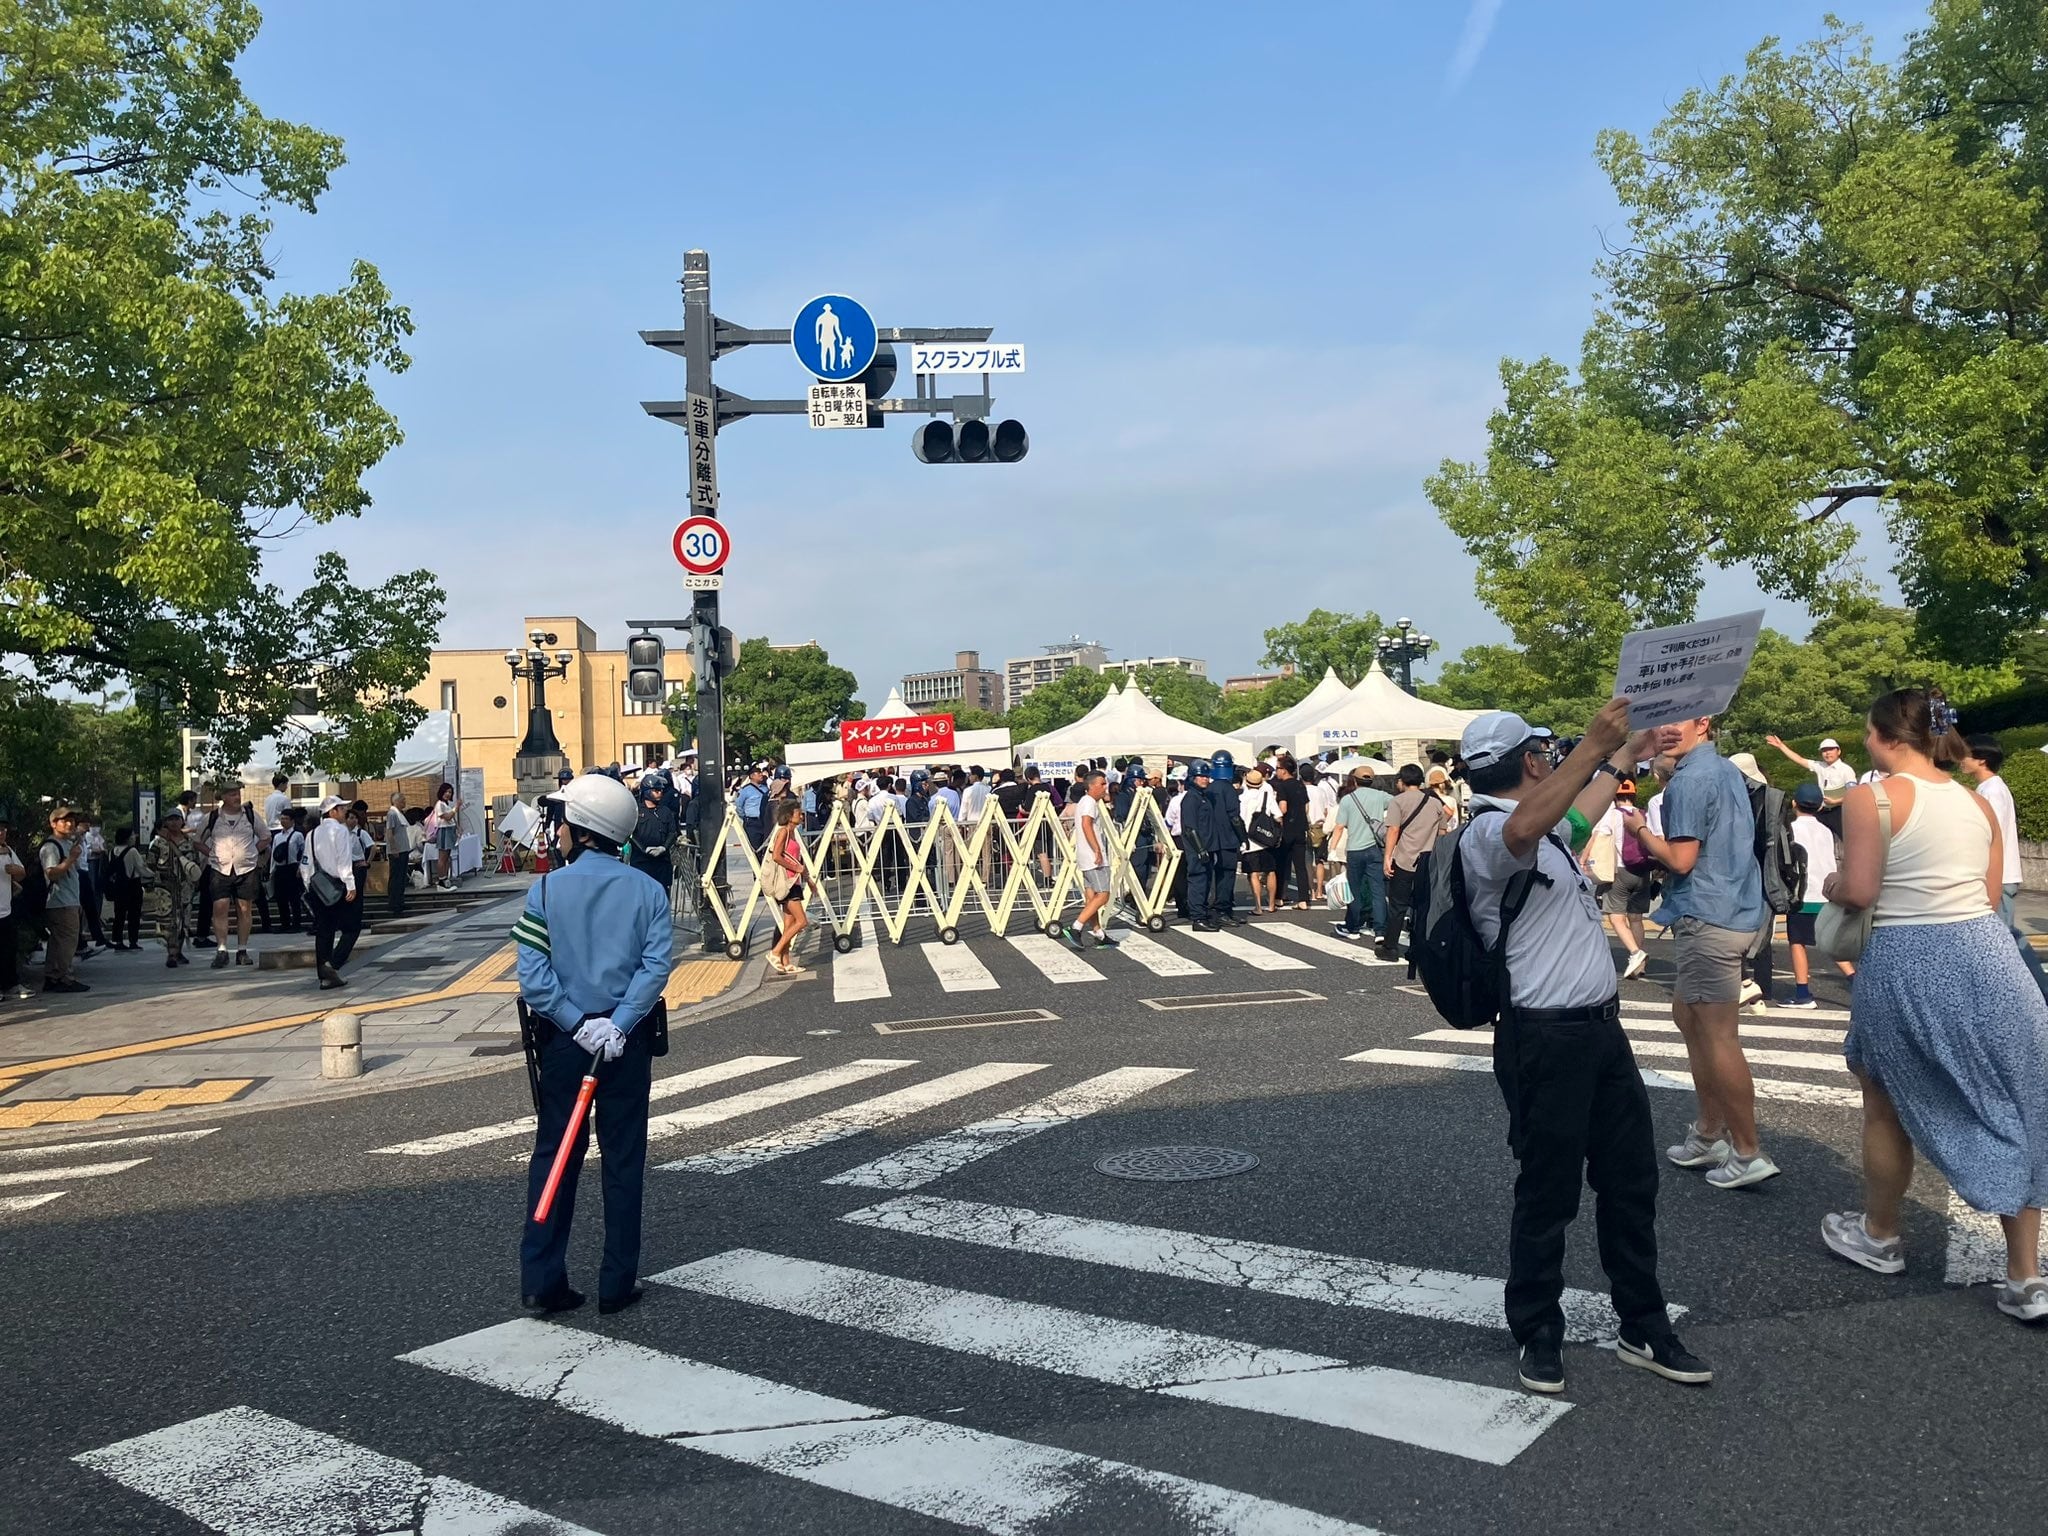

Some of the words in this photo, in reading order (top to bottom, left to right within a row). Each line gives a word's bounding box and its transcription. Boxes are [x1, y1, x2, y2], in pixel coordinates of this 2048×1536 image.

[916, 349, 1021, 369] スクランブル式
[812, 386, 861, 399] 自転車を除く
[692, 398, 713, 505] 歩車分離式
[686, 533, 718, 557] 30
[685, 579, 720, 587] ここから
[1323, 730, 1358, 738] 優先入口
[857, 744, 882, 753] Main
[884, 741, 929, 752] Entrance
[930, 738, 938, 748] 2
